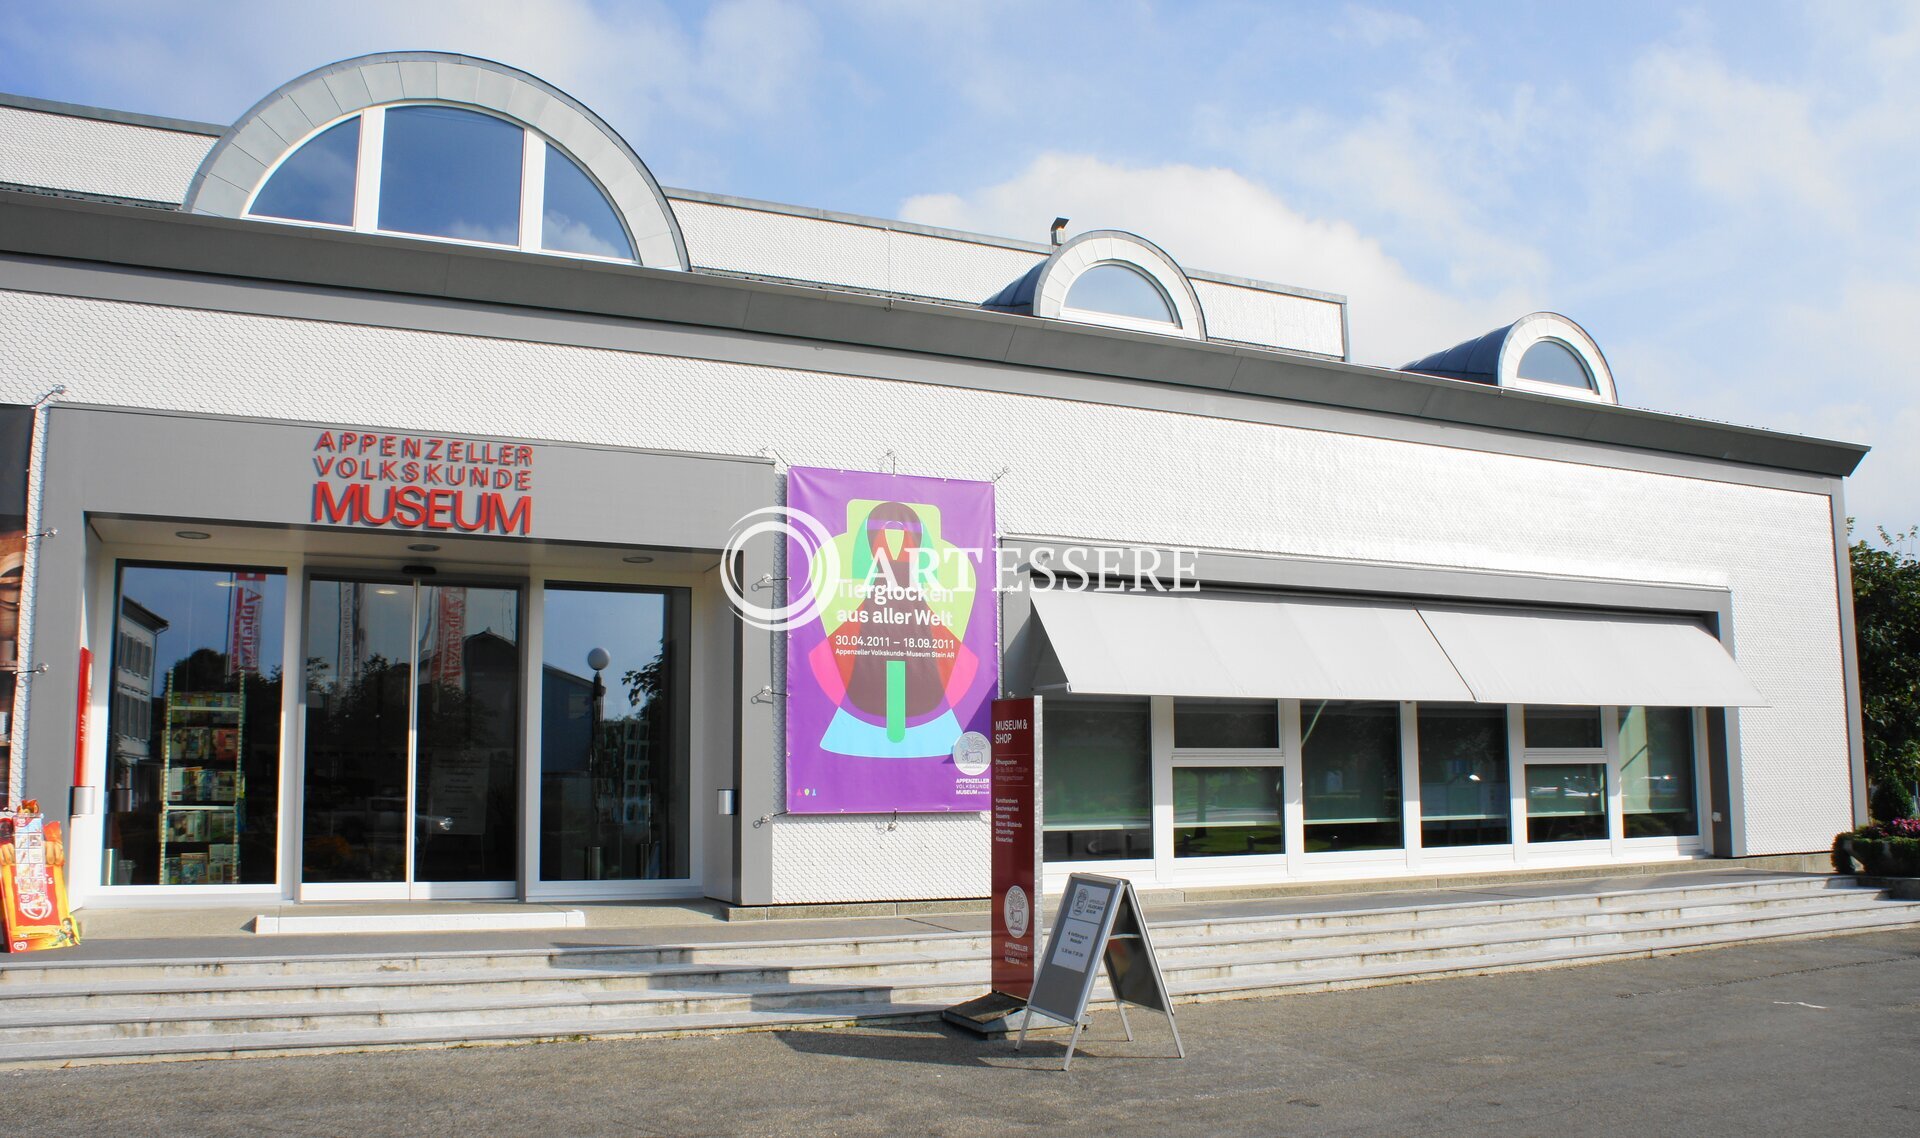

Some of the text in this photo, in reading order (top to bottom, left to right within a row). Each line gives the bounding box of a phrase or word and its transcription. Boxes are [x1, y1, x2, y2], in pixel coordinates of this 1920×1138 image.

[315, 431, 533, 466] APPENZELLER
[316, 455, 532, 490] VOLKSKUNDE
[314, 481, 532, 534] MUSEUM
[837, 578, 954, 605] Tierglocken
[837, 608, 953, 626] aus aller Welt
[835, 635, 890, 647] 30.04.2011
[903, 638, 954, 649] 18.09.2011
[835, 648, 871, 657] Appenzeller
[871, 649, 931, 658] Volkskunde-Museum
[995, 719, 1028, 730] MUSEUM &
[995, 733, 1012, 744] SHOP
